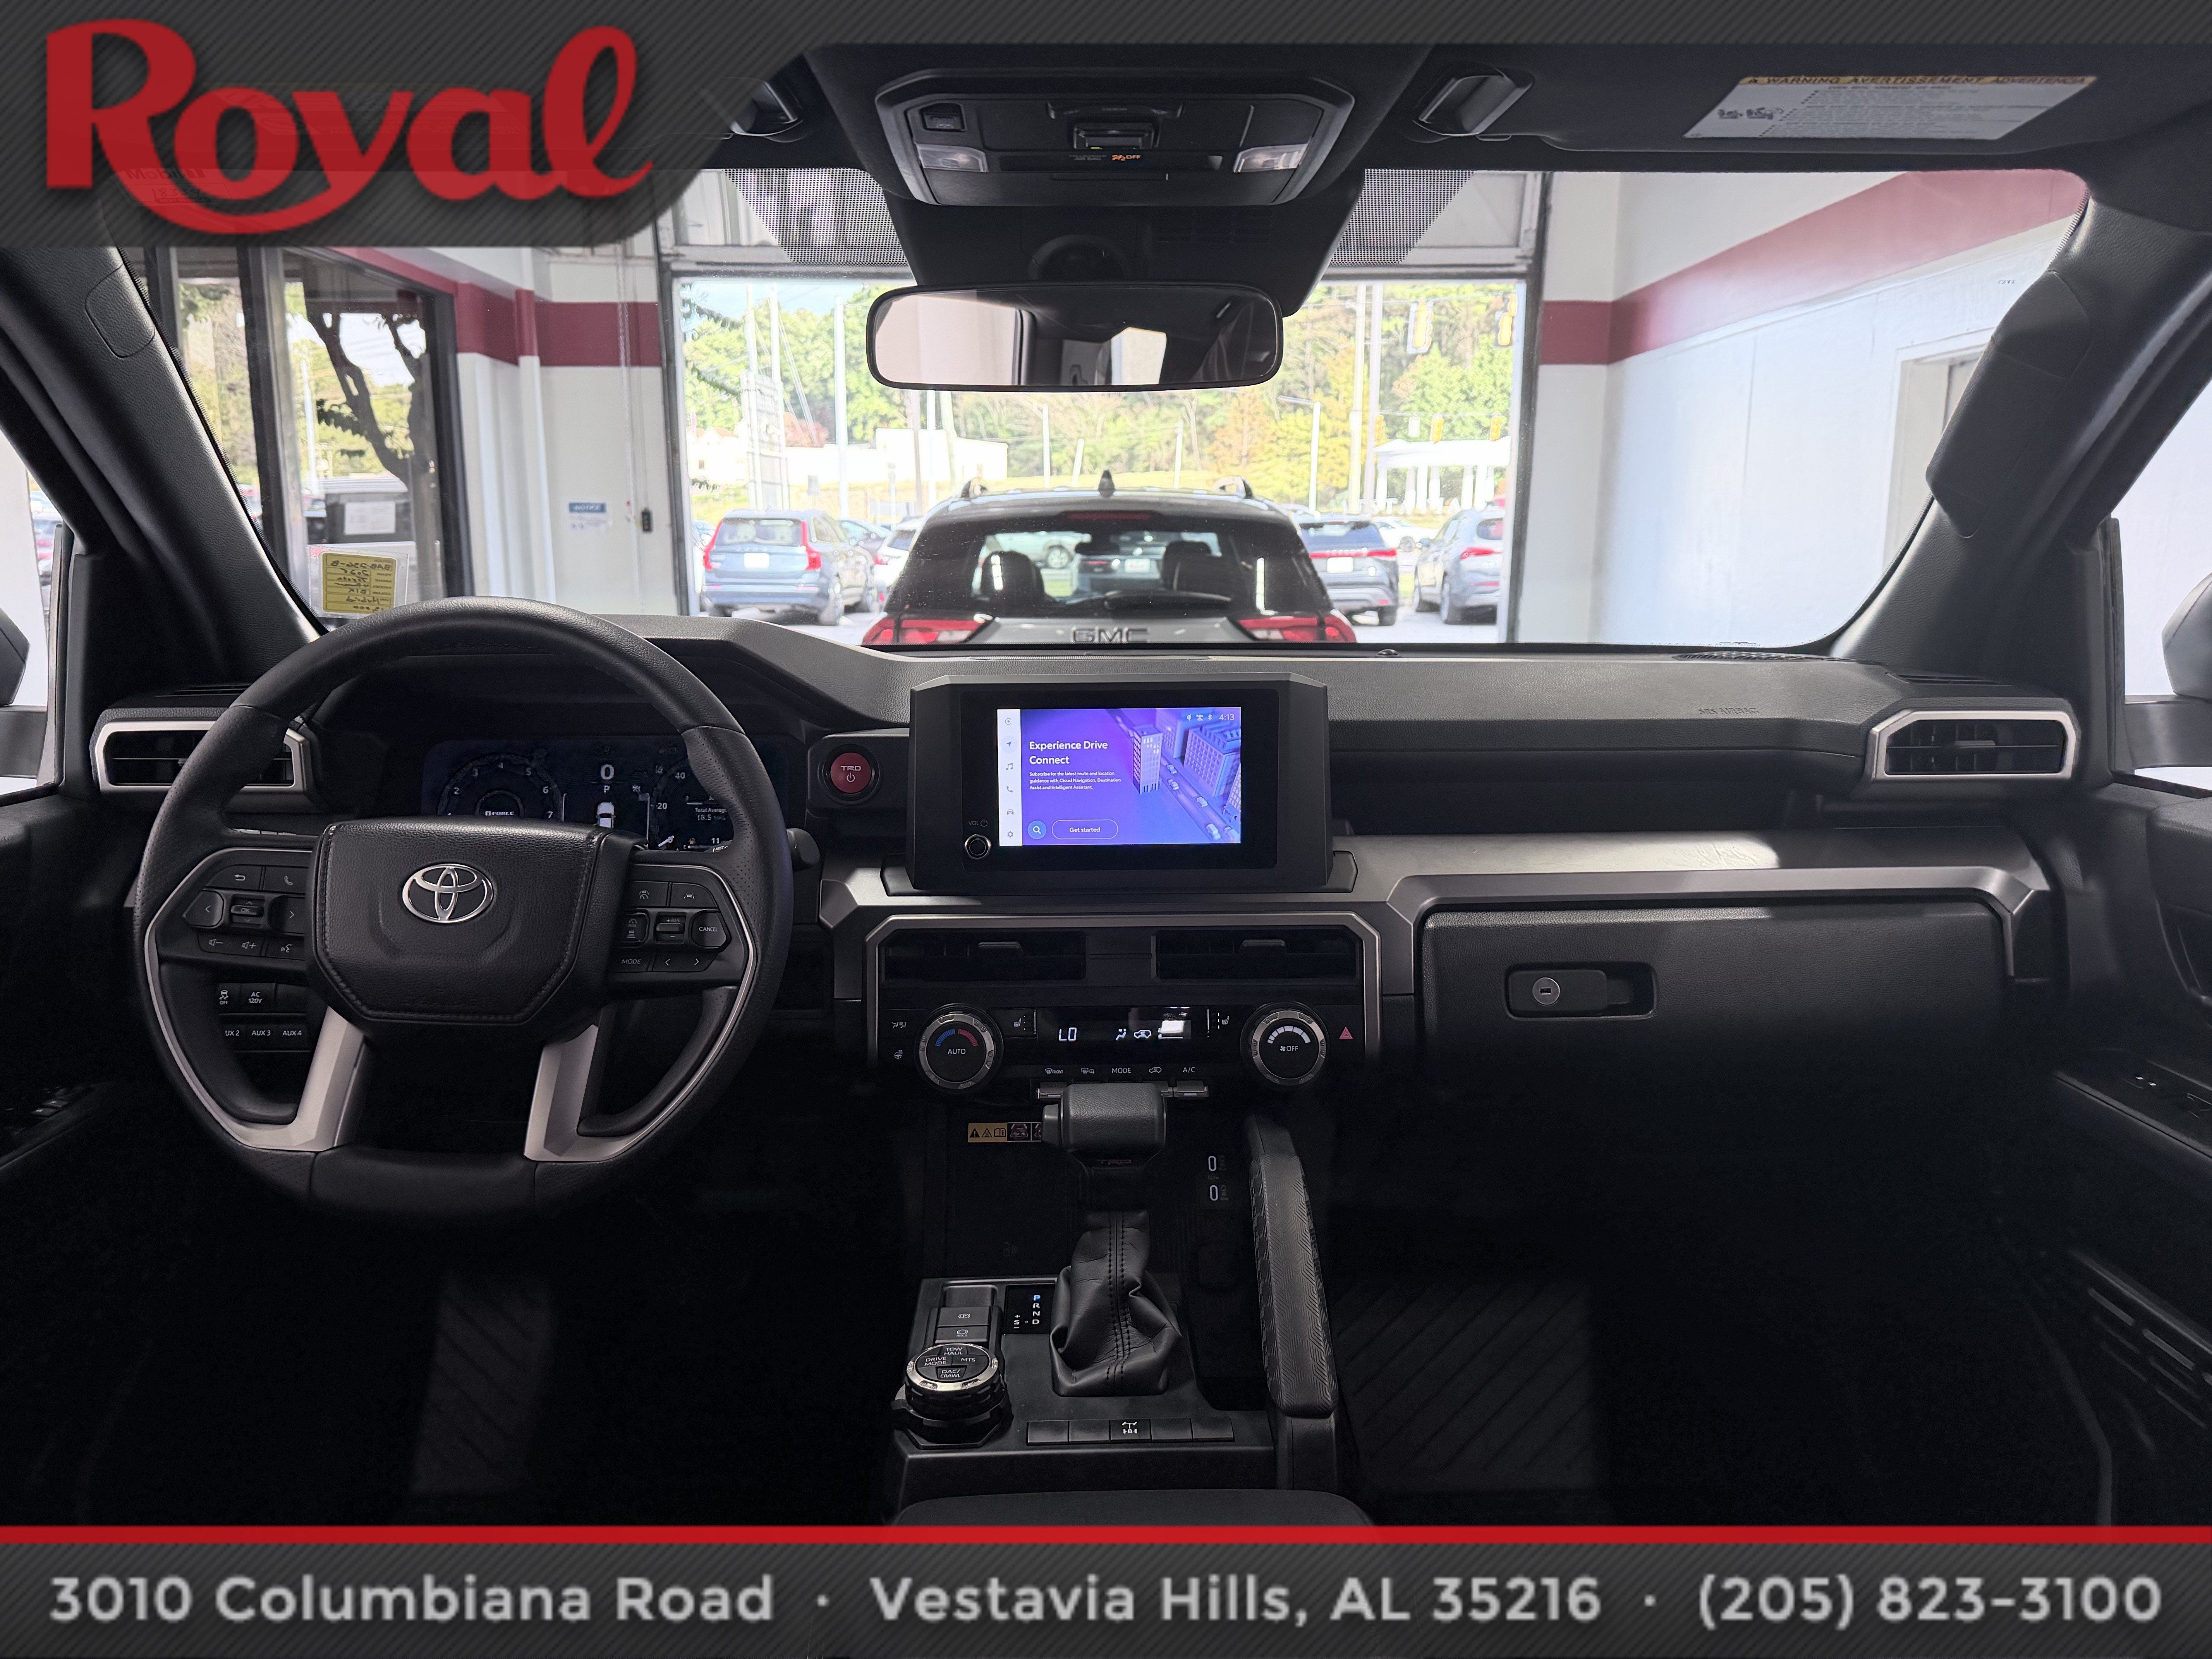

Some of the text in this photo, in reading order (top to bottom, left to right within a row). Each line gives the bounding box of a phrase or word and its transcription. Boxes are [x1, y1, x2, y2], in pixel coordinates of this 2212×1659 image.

[1072, 627, 1148, 644] GMC
[1029, 740, 1108, 751] Experience Drive
[1029, 756, 1070, 764] Connect
[601, 764, 615, 780] 0
[675, 771, 686, 780] 40
[453, 787, 460, 795] 2
[547, 811, 554, 819] 7
